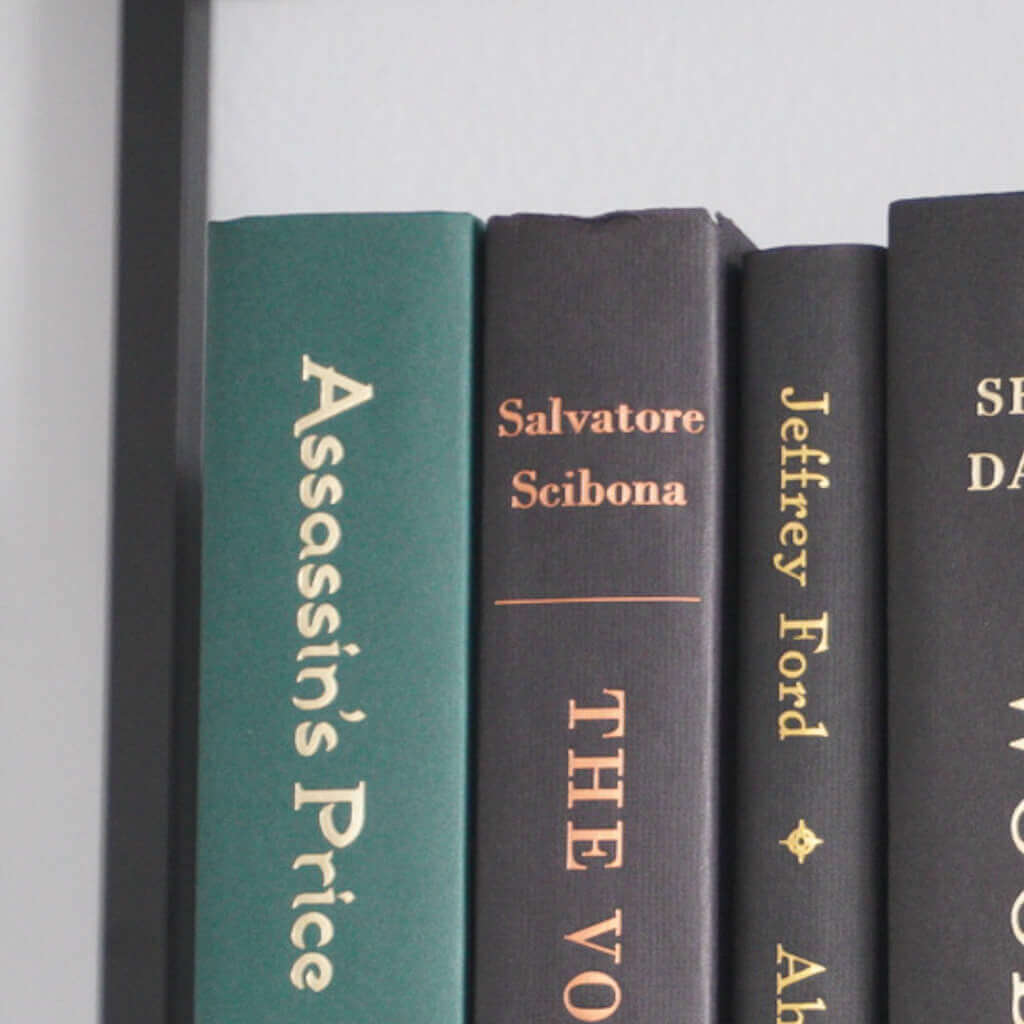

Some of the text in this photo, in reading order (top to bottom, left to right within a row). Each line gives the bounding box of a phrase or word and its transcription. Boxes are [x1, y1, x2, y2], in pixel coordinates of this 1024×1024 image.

[498, 397, 705, 437] Salvatore
[511, 468, 688, 508] Scibona
[773, 387, 831, 740] Jeffrey Ford
[289, 354, 374, 993] Assassin's Price
[566, 688, 625, 870] THE
